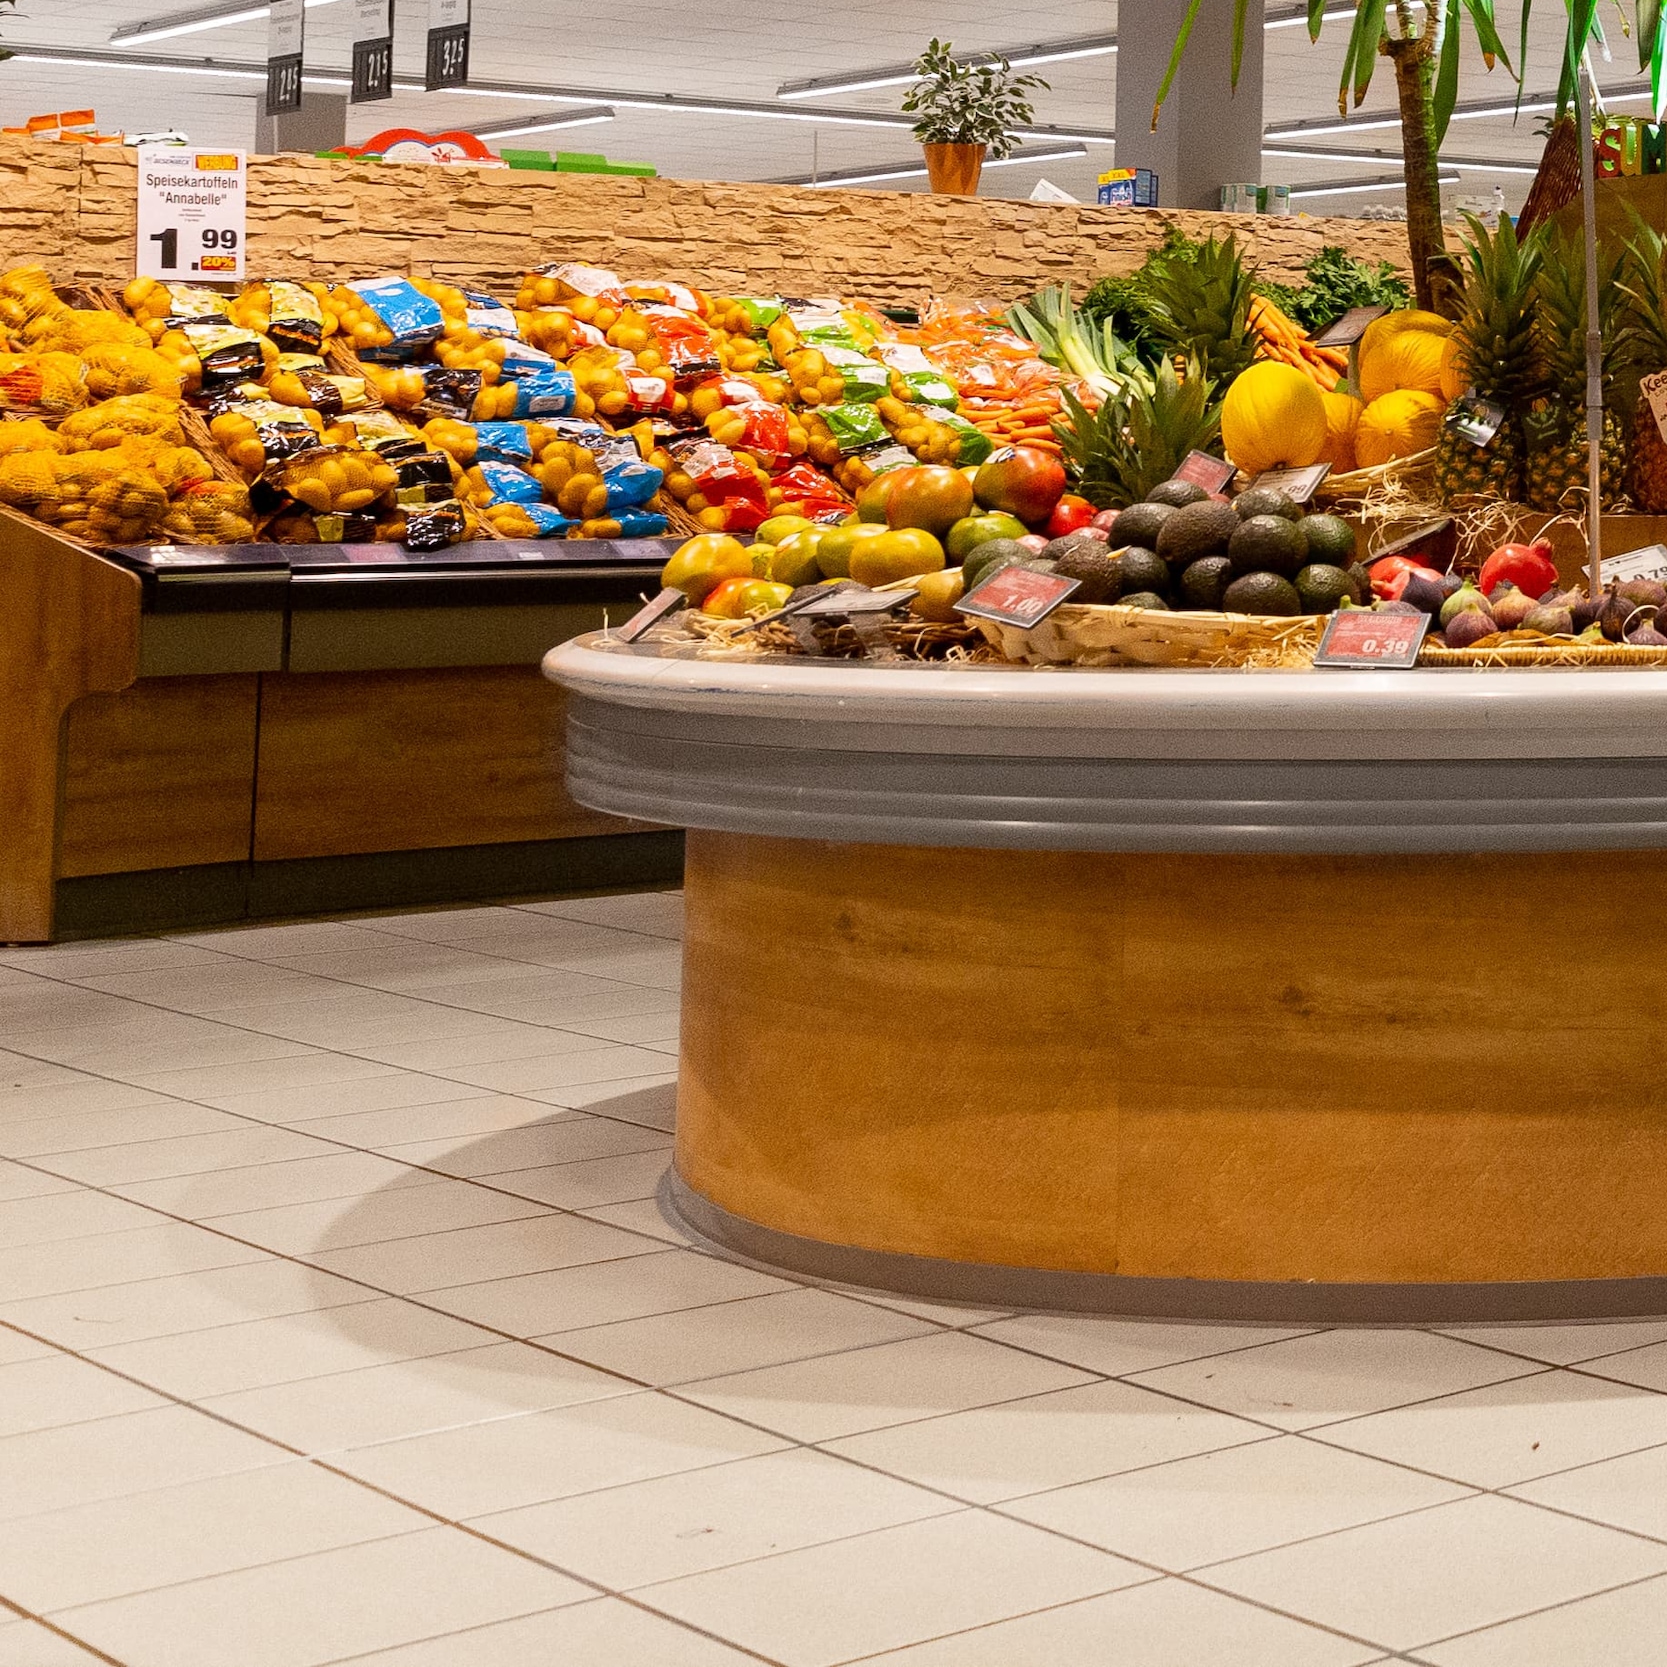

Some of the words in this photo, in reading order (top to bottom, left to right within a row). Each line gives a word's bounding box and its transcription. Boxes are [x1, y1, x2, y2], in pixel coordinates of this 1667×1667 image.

[442, 38, 465, 76] 3.25
[367, 50, 388, 87] 2.15
[146, 174, 238, 189] Speisekartoffeln
[202, 256, 235, 267] 20%
[1001, 594, 1044, 613] 1.00
[1362, 638, 1409, 654] 0.39
